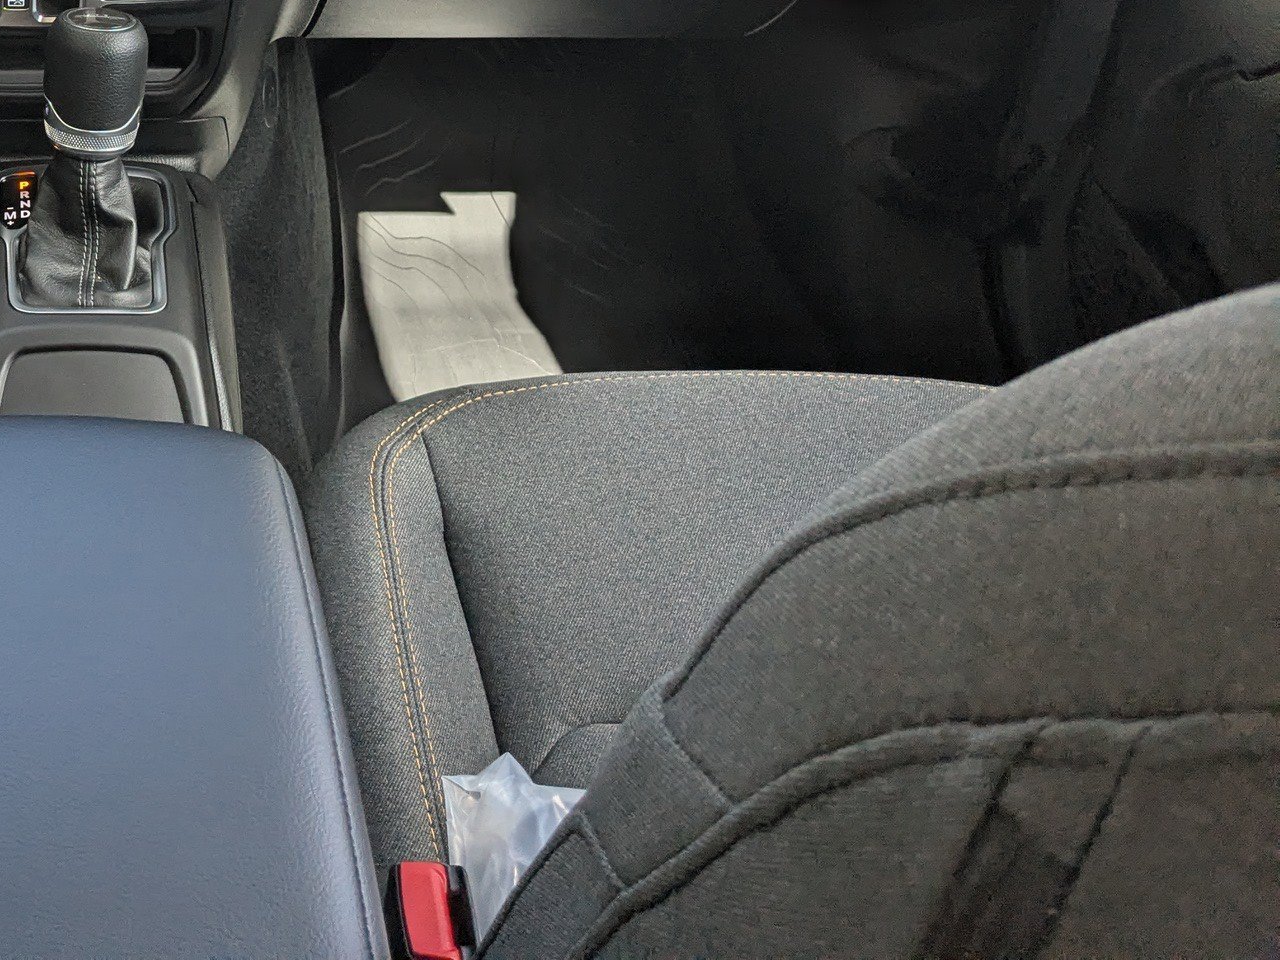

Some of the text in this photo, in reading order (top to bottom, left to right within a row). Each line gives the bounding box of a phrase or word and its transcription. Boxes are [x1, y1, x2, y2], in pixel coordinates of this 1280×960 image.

[19, 181, 29, 190] P
[20, 191, 29, 199] R
[20, 200, 31, 208] N
[4, 211, 16, 220] M
[20, 210, 31, 218] D
